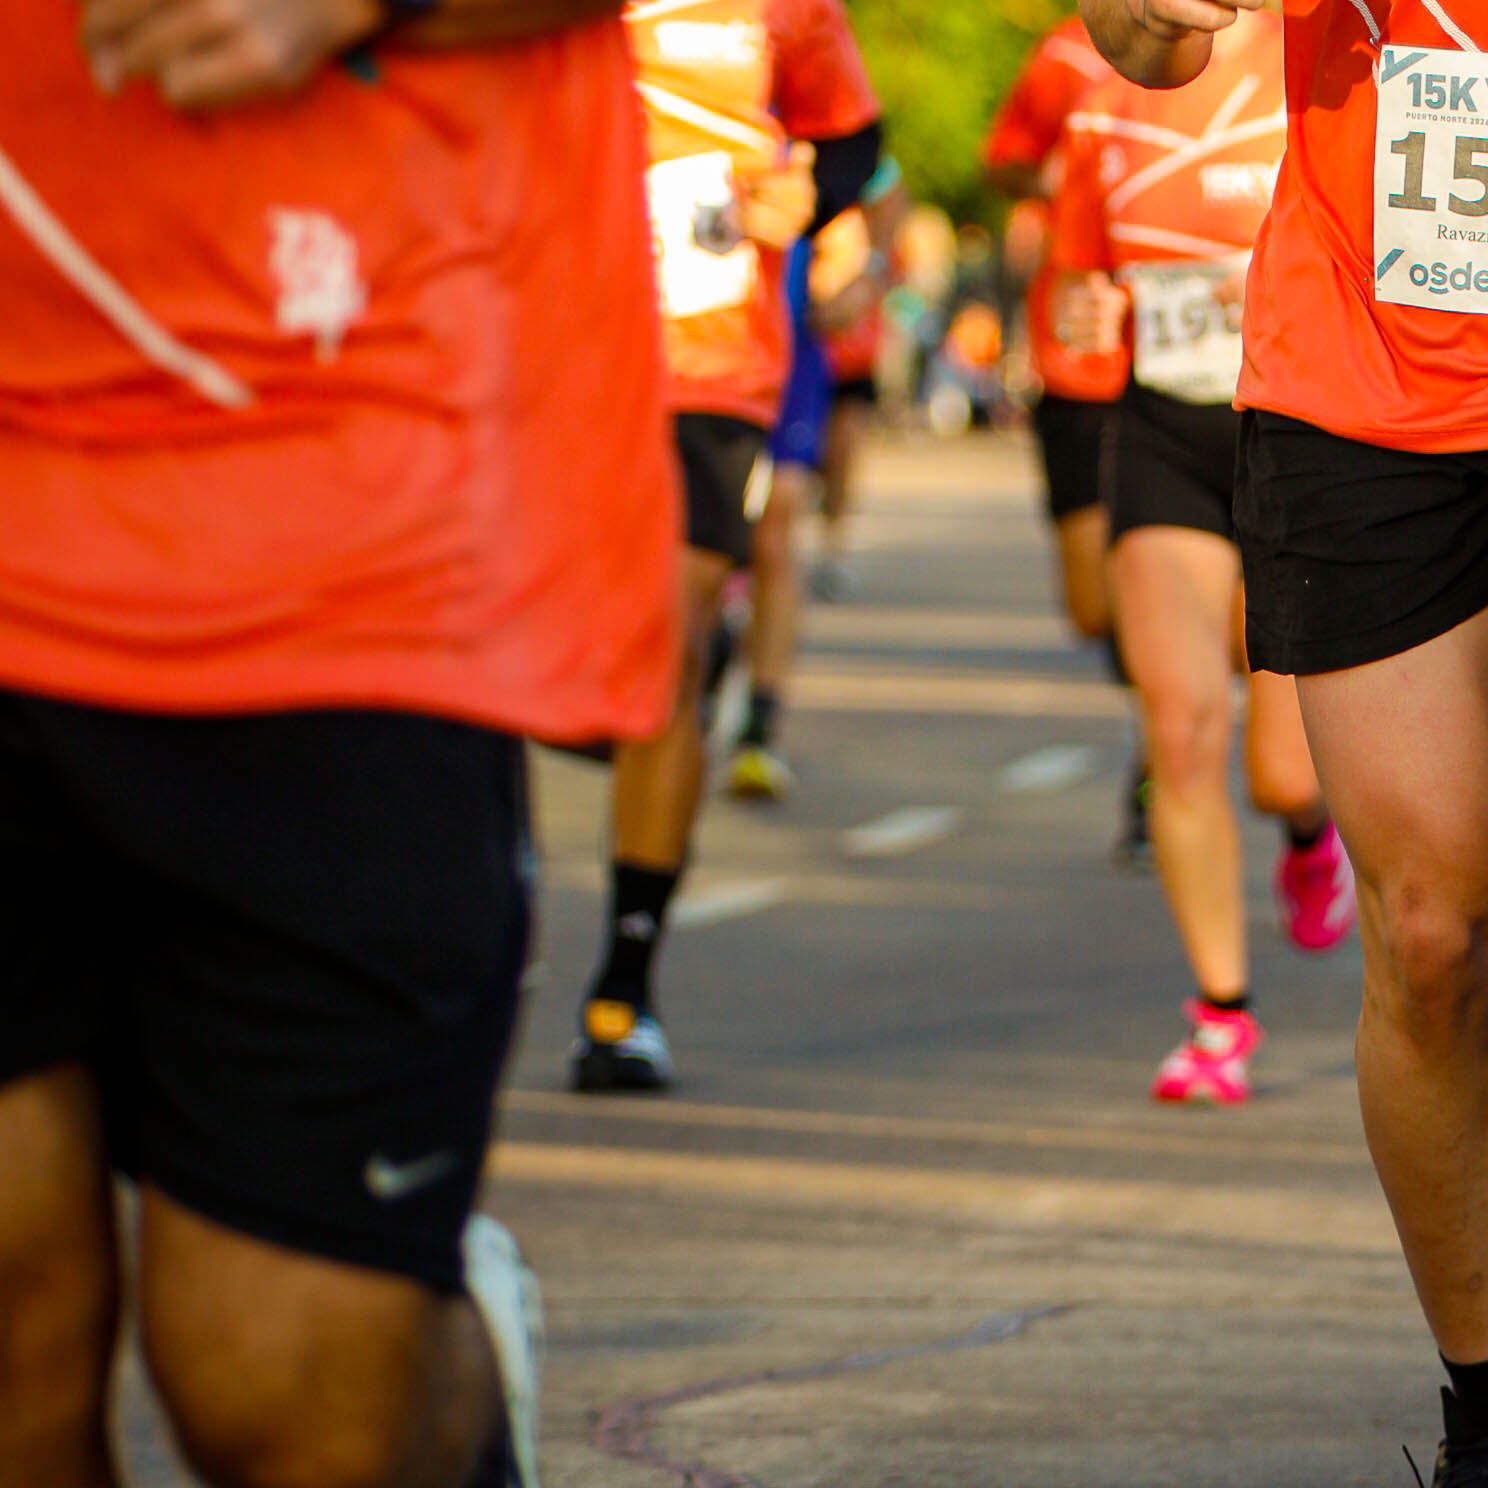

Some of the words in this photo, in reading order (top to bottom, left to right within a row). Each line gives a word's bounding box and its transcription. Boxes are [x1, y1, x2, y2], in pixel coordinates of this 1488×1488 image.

[1406, 71, 1479, 113] 15K
[1405, 111, 1438, 121] PUERTO
[1440, 115, 1467, 124] NORTE
